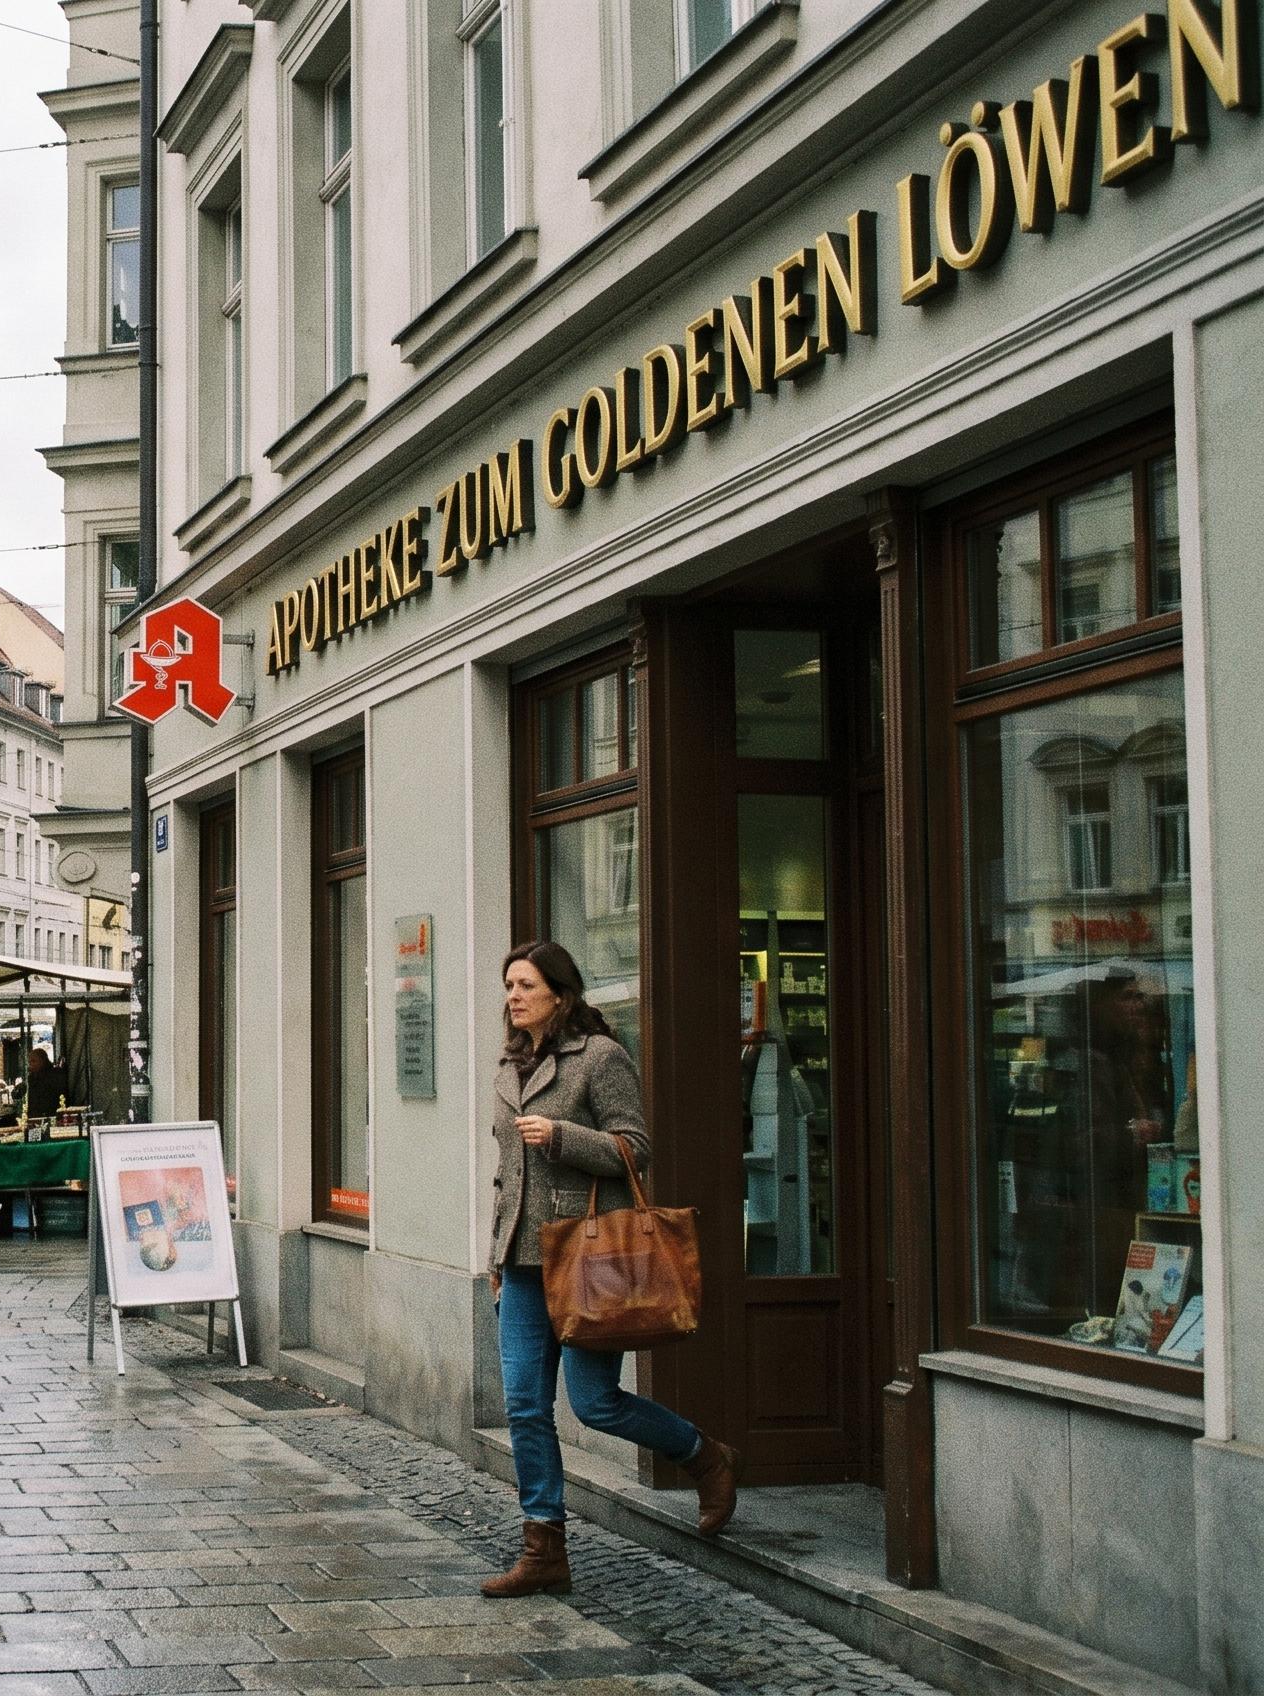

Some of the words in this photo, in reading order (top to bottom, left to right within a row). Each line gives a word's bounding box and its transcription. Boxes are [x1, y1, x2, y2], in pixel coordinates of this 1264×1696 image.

[265, 507, 429, 676] APOTHEKE
[436, 439, 533, 578] ZUM
[542, 210, 872, 509] GOLDENEN
[896, 0, 1254, 306] LÖWEN
